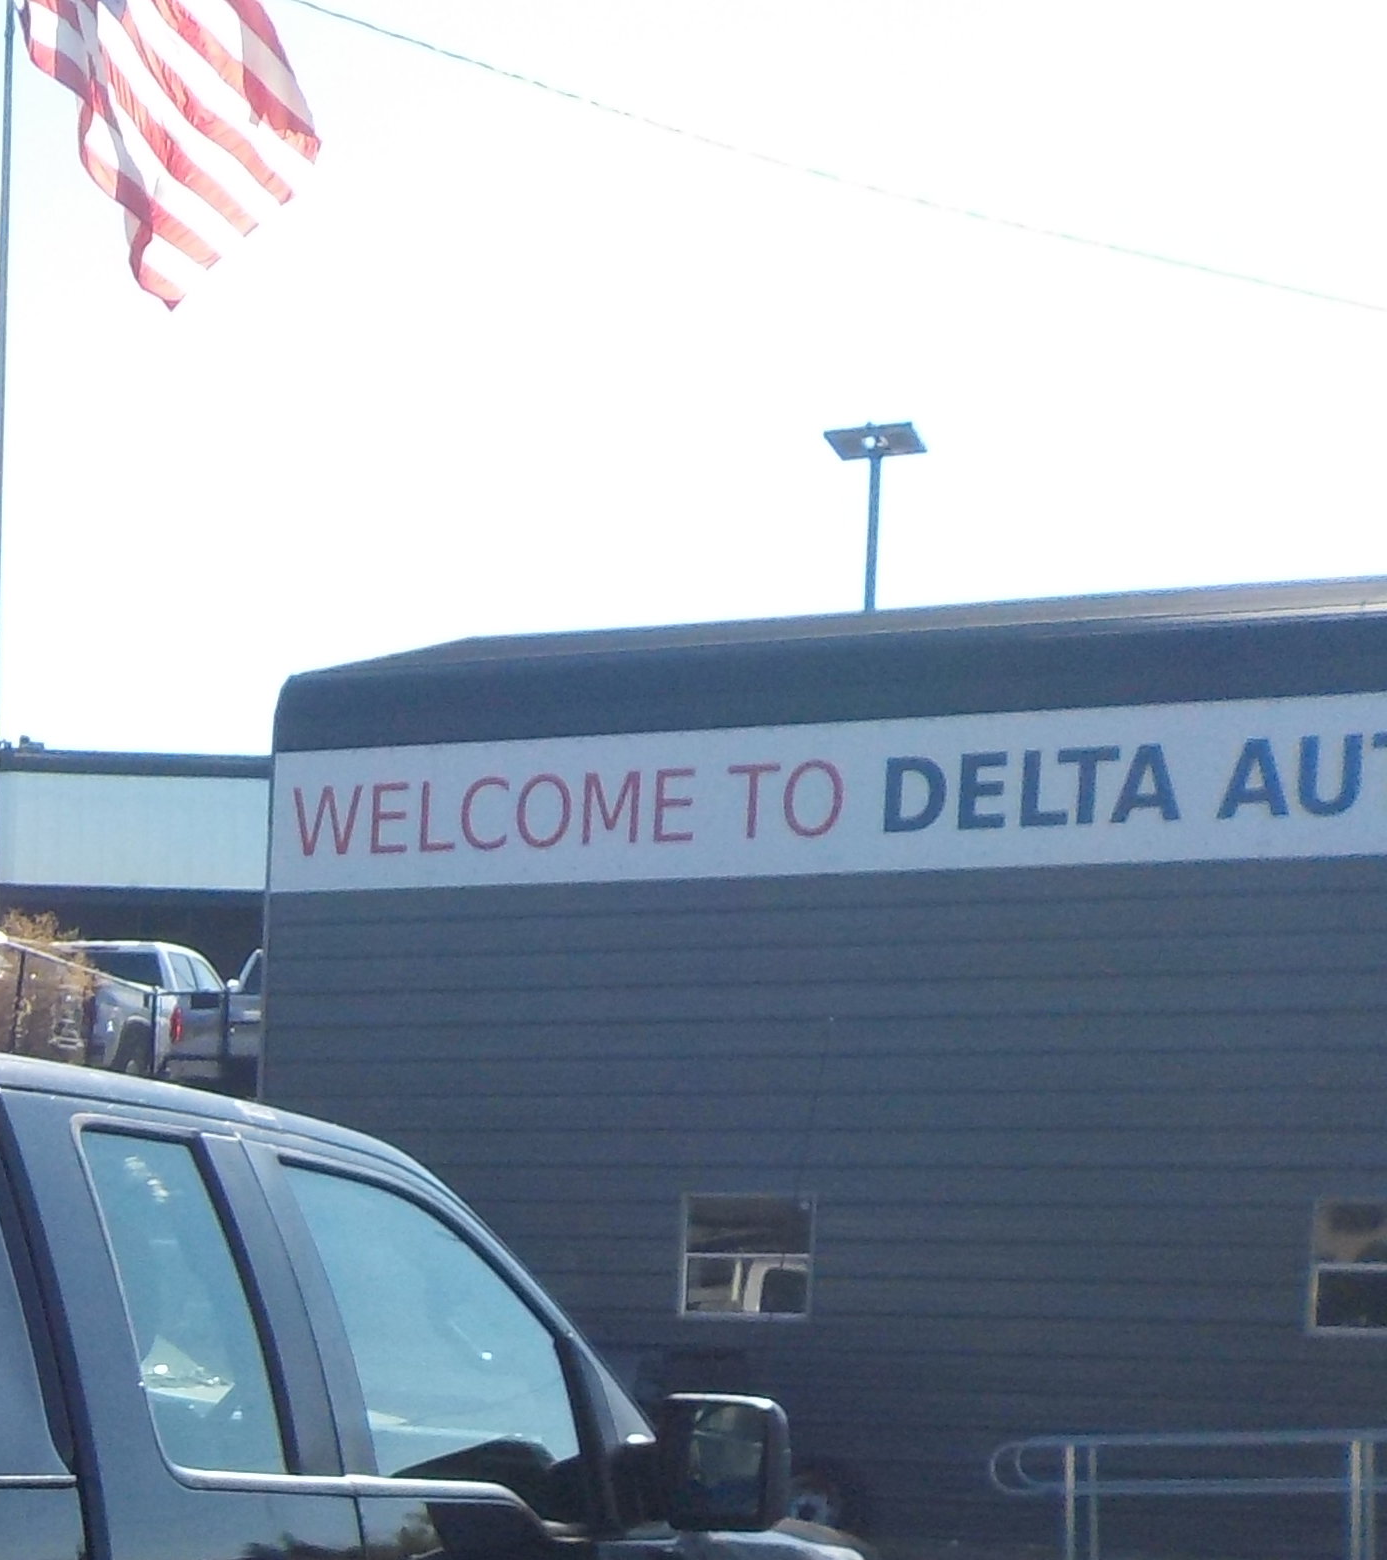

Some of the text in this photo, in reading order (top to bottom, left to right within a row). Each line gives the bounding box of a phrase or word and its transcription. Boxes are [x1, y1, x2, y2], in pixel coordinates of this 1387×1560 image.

[293, 732, 1387, 857] WELCOME TO DELTA AU
